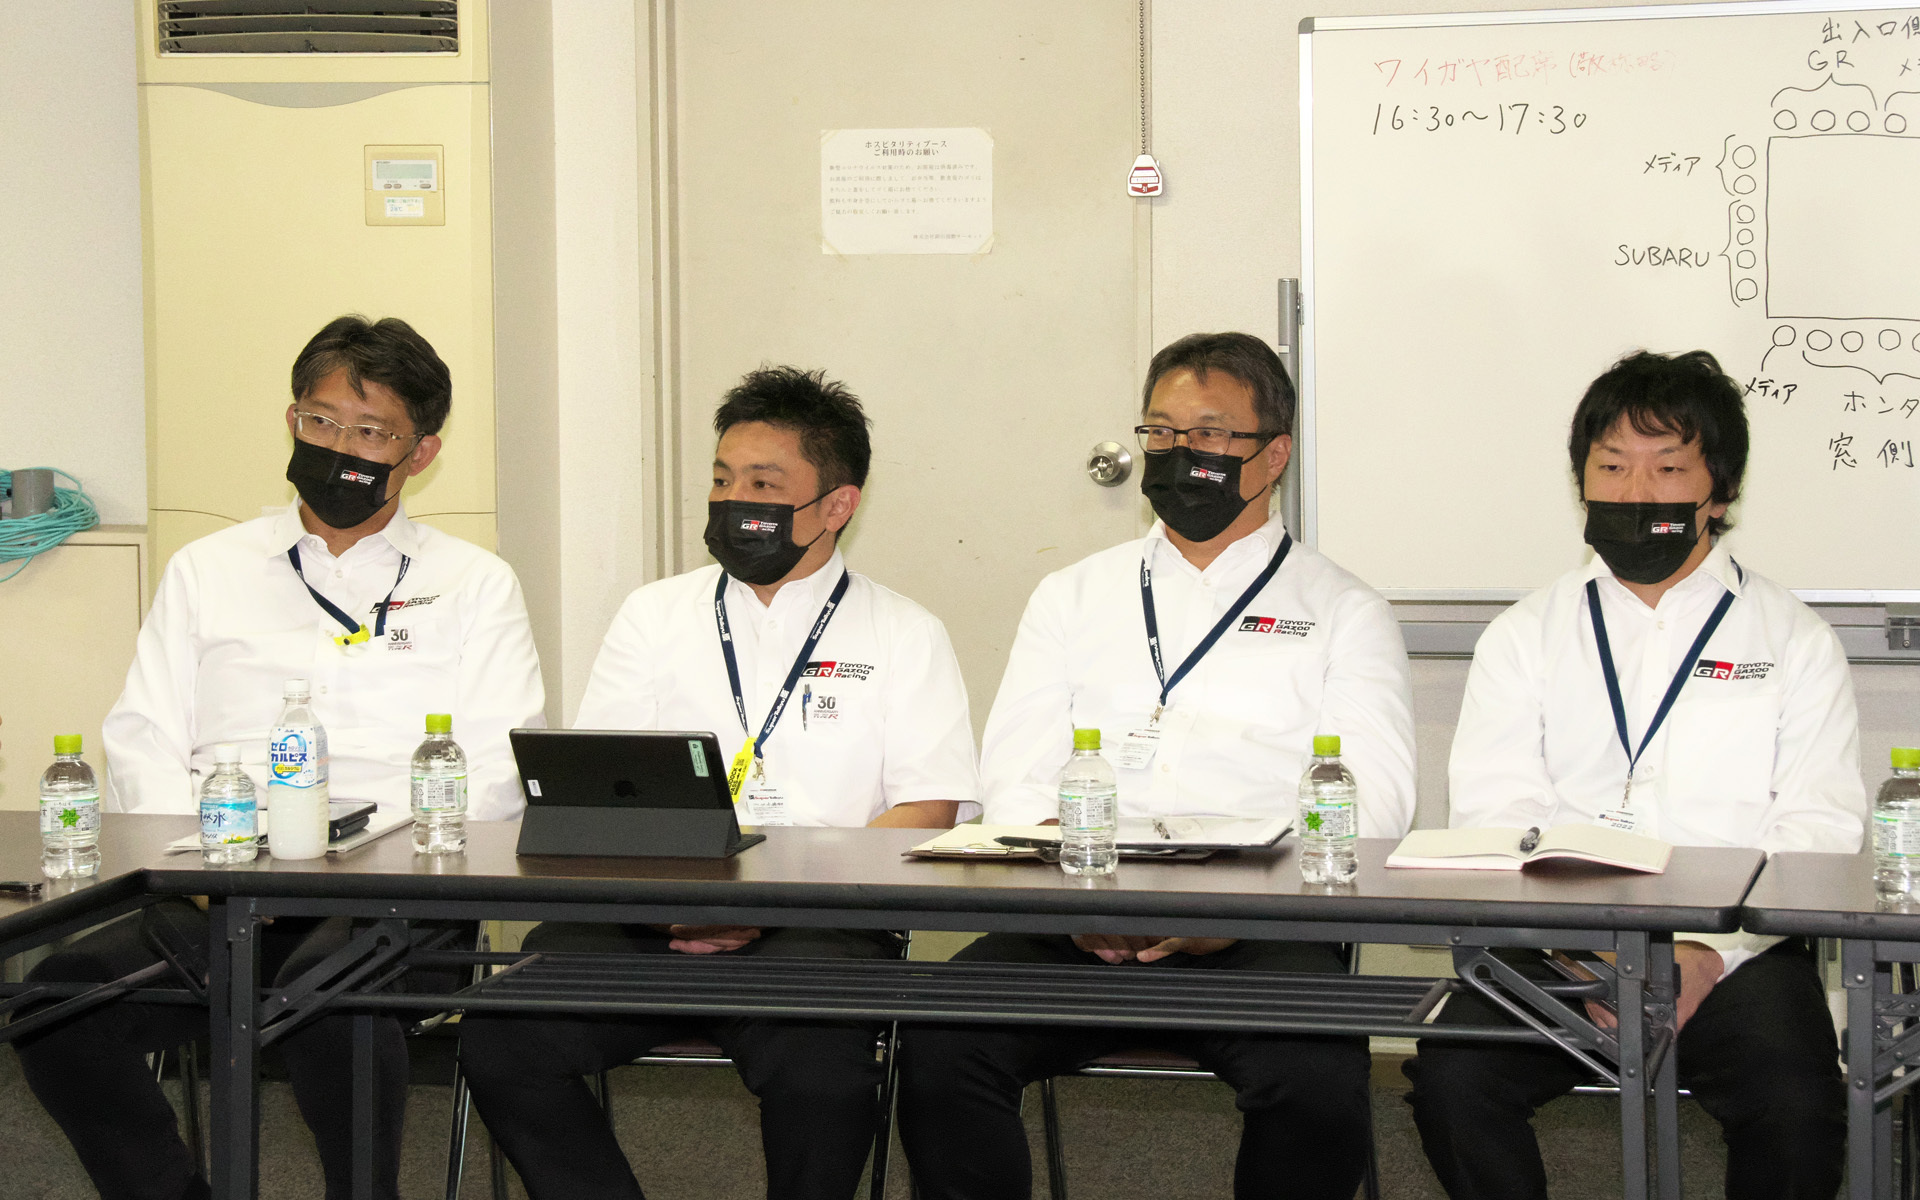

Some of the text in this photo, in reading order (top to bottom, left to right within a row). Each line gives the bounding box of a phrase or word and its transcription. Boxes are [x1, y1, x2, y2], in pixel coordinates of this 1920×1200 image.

[1808, 50, 1855, 71] GR
[1643, 152, 1701, 176] メディア
[1614, 244, 1709, 268] SUBARU
[1744, 377, 1798, 405] メディア
[1239, 622, 1272, 633] GR
[1279, 619, 1316, 627] TOYOTA
[390, 629, 408, 642] 30
[1273, 629, 1308, 637] Racing
[803, 667, 833, 677] GR
[838, 662, 875, 671] TOYOTA
[834, 673, 868, 681] Racing
[1694, 667, 1730, 680] GR
[818, 696, 836, 709] 30
[271, 742, 288, 751] ゼロ
[271, 753, 307, 762] カルピス
